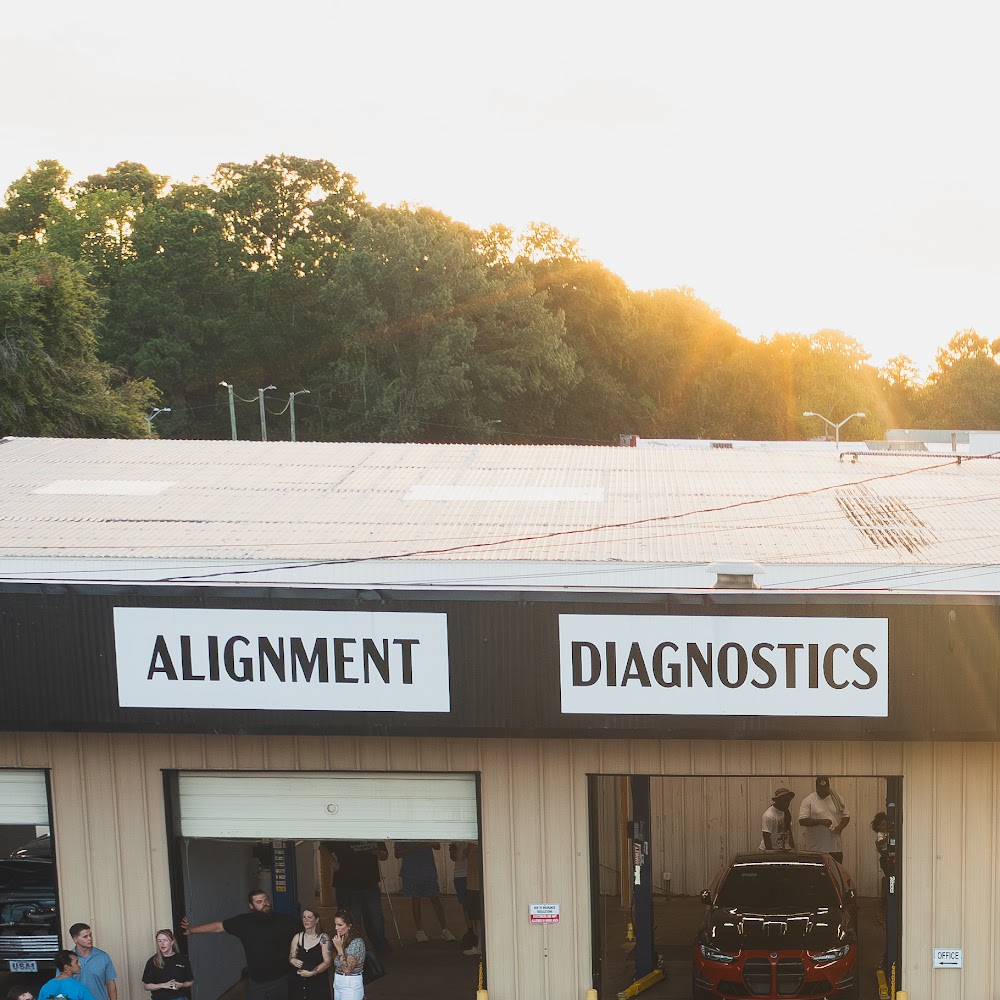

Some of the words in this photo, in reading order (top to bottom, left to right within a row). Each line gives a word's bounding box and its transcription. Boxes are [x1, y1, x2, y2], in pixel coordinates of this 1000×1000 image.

[146, 634, 421, 685] ALIGNMENT
[570, 640, 879, 691] DIAGNOSTICS
[937, 951, 960, 960] OFFICE
